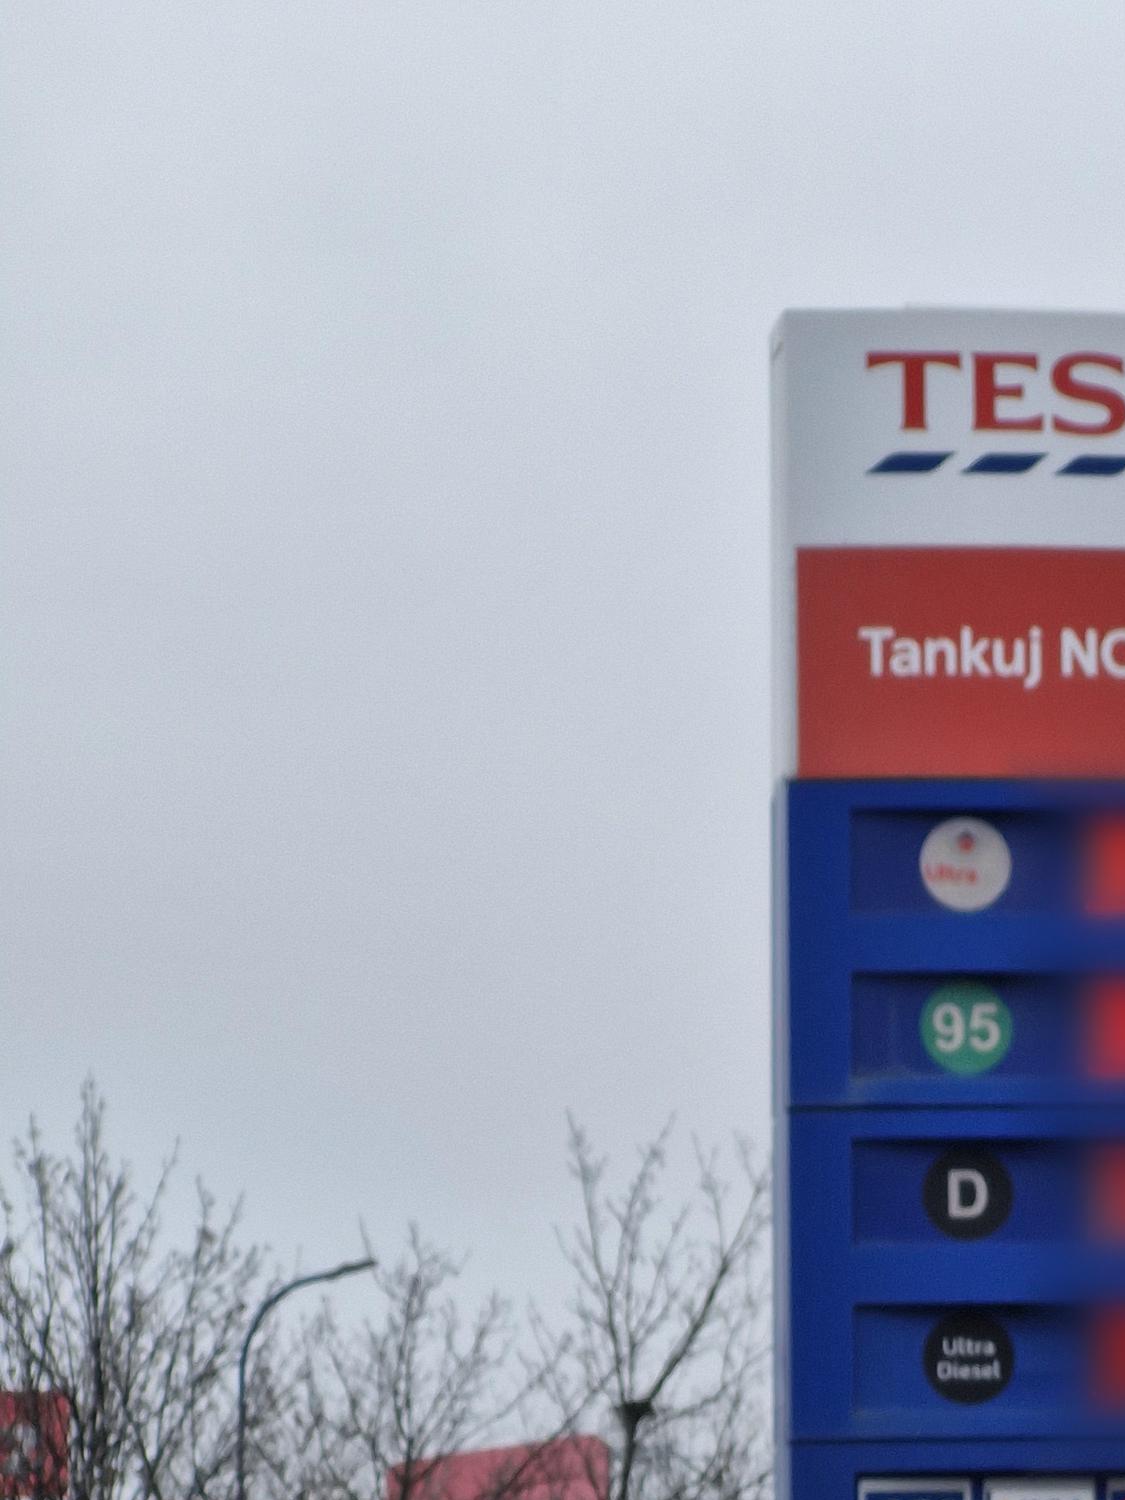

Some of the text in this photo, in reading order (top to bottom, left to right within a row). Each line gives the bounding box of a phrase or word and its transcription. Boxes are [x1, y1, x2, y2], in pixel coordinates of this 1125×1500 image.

[859, 626, 1043, 689] Tankuj
[932, 1003, 1000, 1053] 95
[947, 1169, 989, 1219] D
[942, 1336, 997, 1356] Ultra
